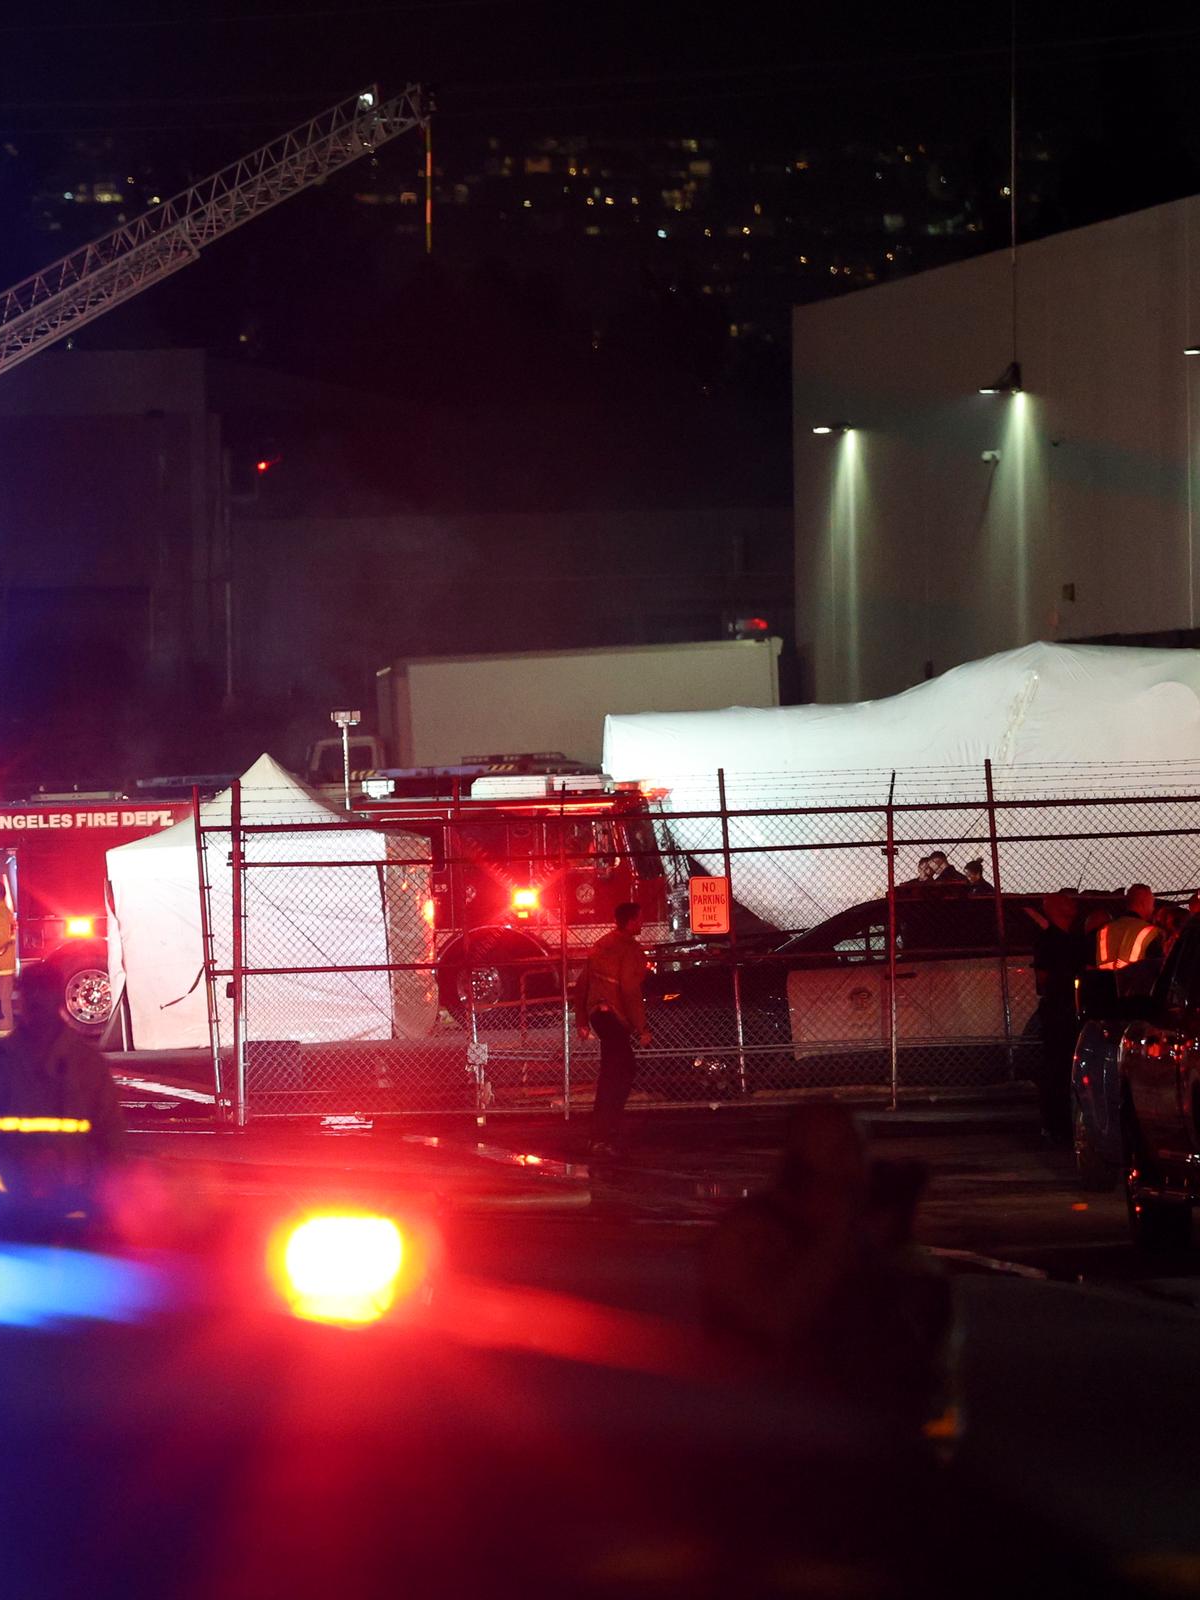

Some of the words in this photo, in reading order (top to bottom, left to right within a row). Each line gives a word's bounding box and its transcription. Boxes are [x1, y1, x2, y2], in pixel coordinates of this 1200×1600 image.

[76, 812, 119, 828] FIRE
[121, 810, 174, 827] DEPT.
[702, 882, 716, 892] NO
[693, 894, 726, 905] PARKING
